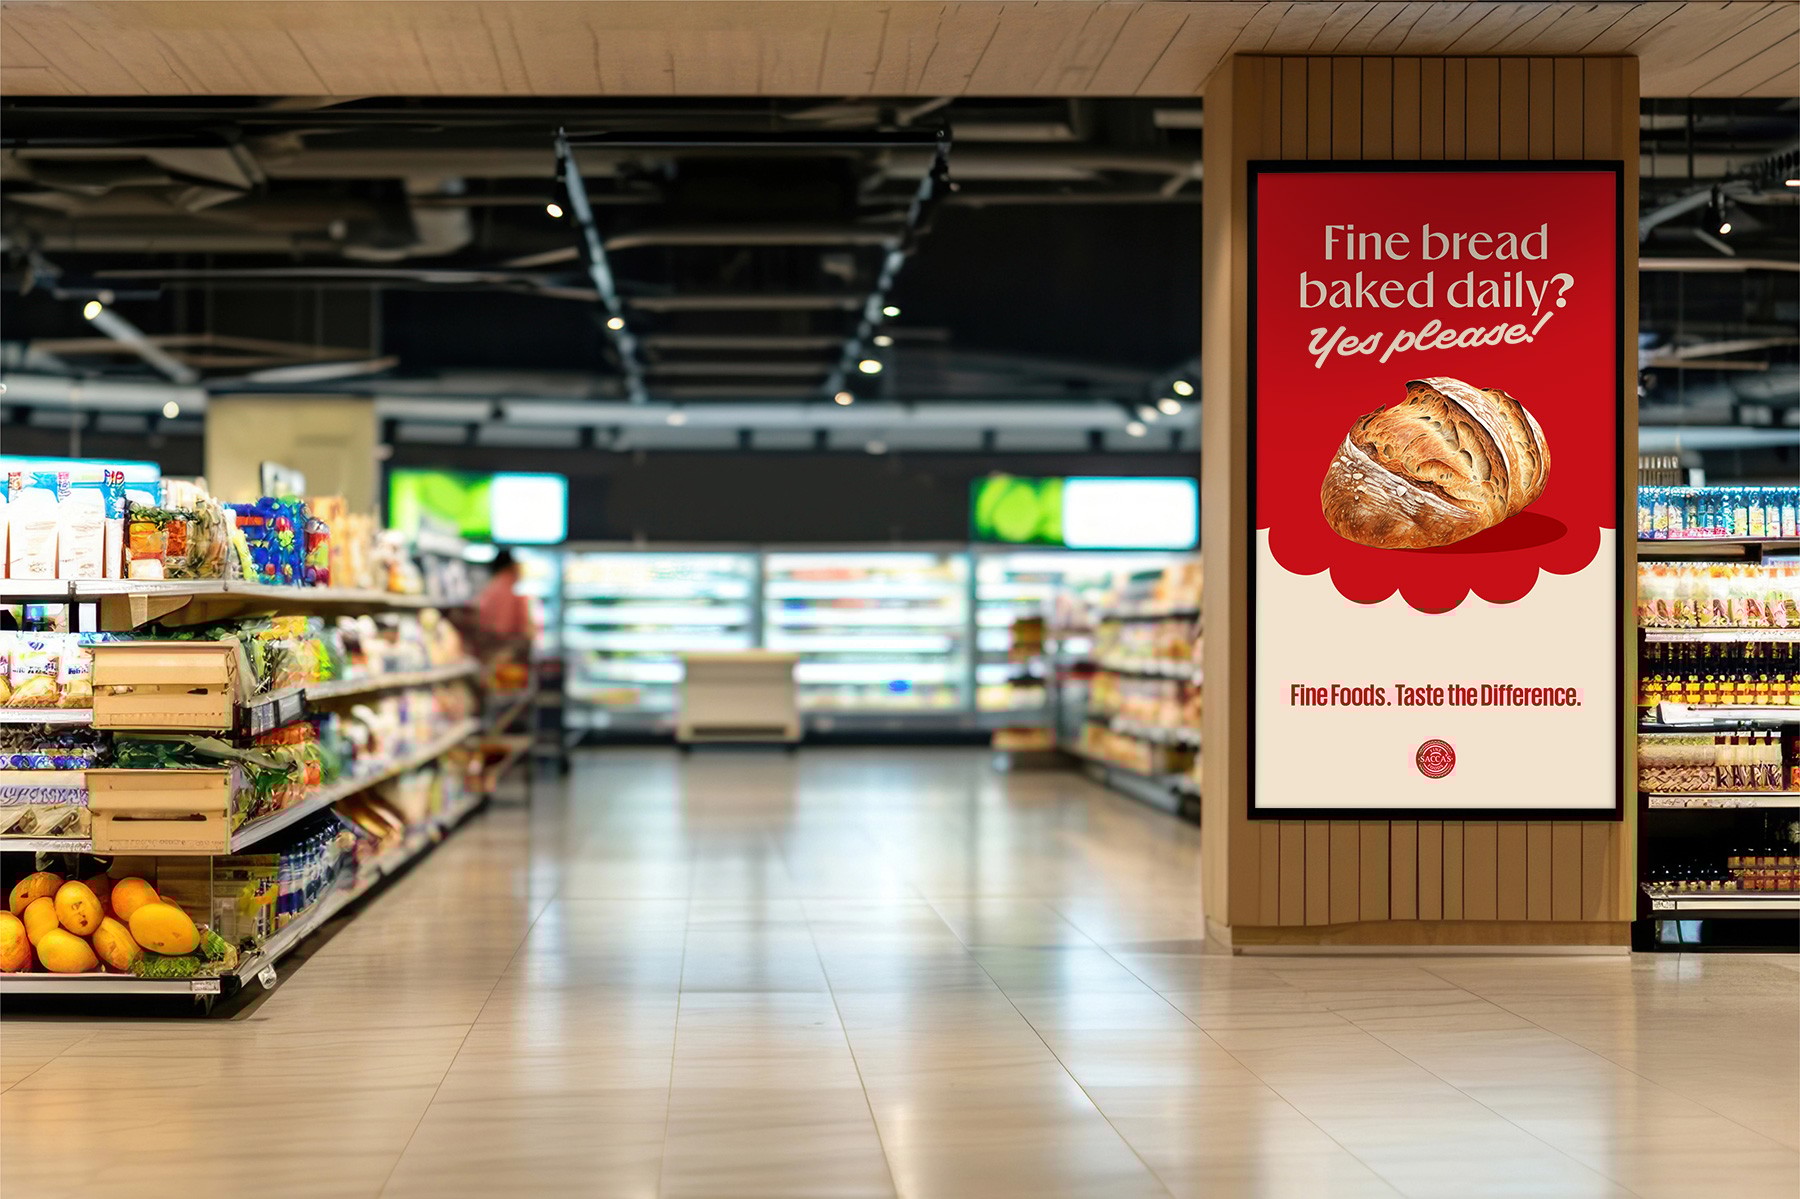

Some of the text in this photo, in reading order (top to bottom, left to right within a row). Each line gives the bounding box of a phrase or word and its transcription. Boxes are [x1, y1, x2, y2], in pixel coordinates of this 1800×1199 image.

[1325, 223, 1548, 261] Fine bread
[1299, 271, 1575, 317] baked daily?
[1308, 310, 1555, 369] Yes please!
[1290, 683, 1583, 707] Fine Foods. Taste the Difference.
